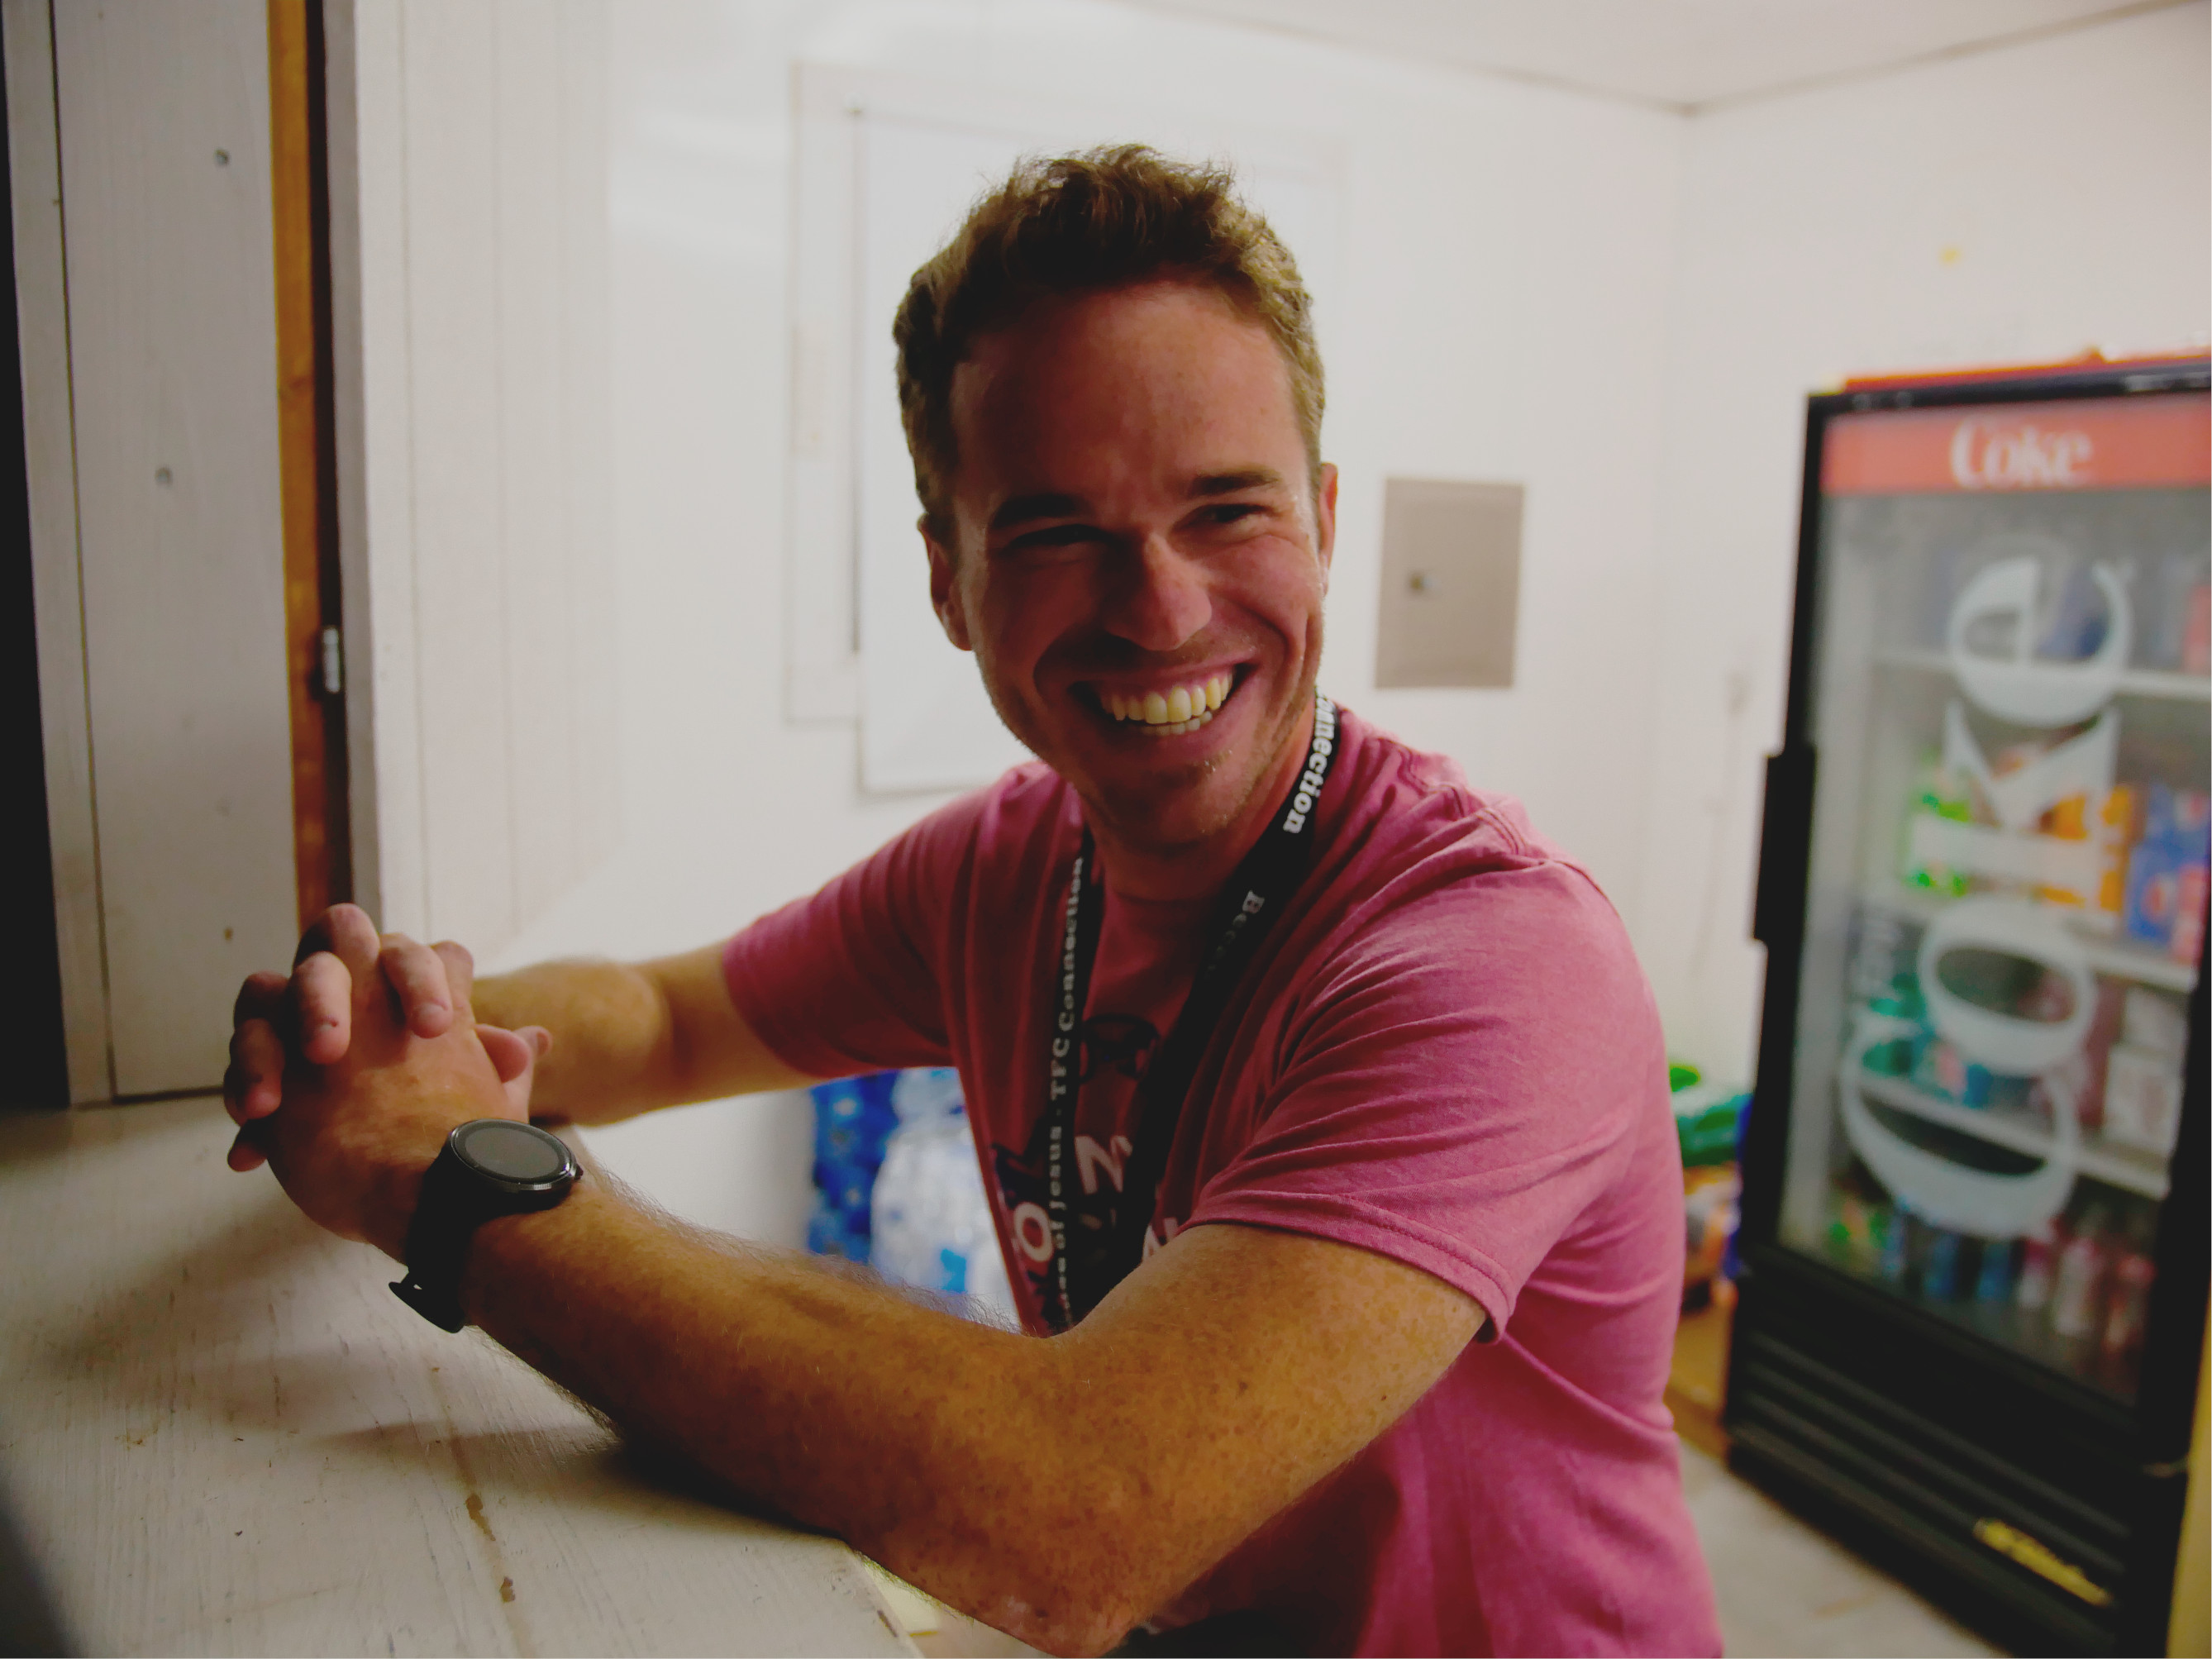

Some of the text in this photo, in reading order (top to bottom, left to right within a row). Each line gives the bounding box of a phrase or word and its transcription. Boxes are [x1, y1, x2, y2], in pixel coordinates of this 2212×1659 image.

[1949, 419, 2094, 489] Coke
[1058, 856, 1085, 1032] Connection
[1839, 555, 2135, 1239] Coke
[1050, 1037, 1071, 1102] TFC
